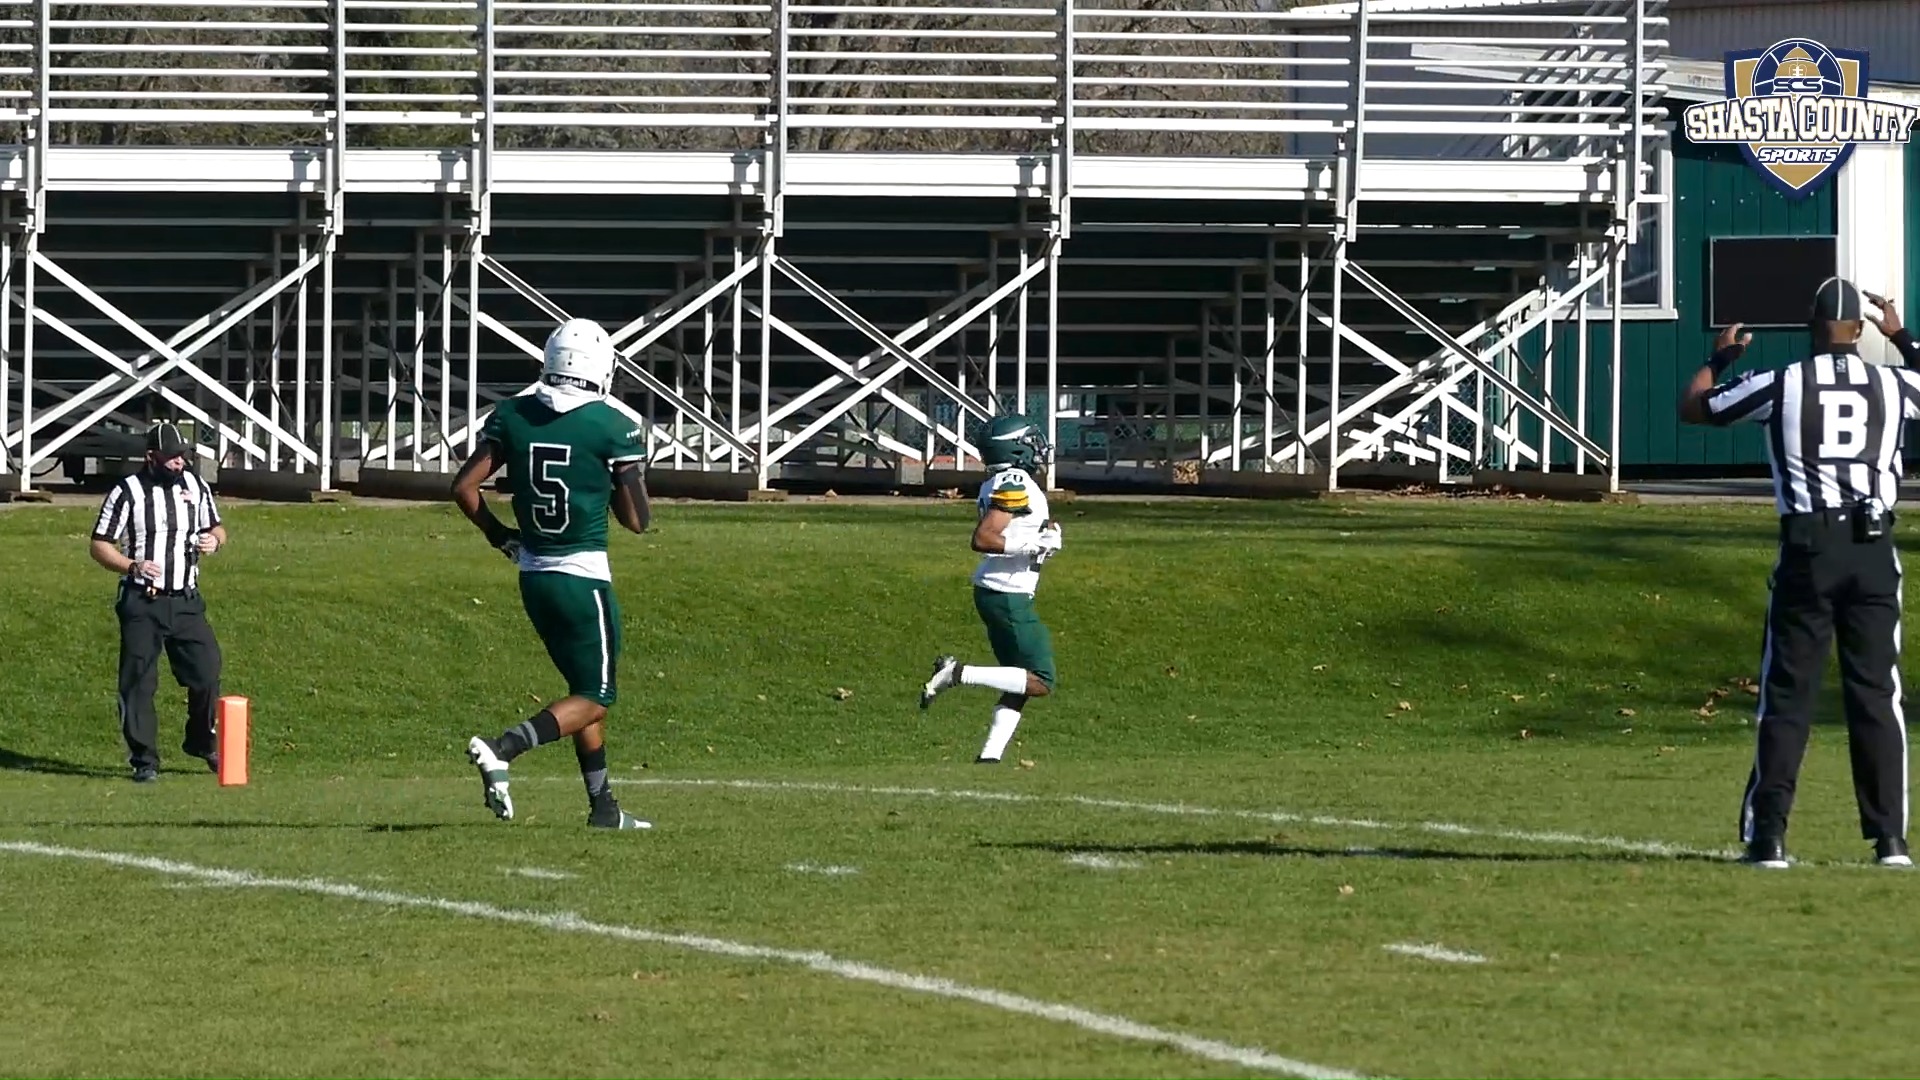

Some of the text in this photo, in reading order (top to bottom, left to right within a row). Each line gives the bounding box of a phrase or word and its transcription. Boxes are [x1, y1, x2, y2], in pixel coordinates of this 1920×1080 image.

[550, 375, 587, 388] Riddell
[1818, 390, 1869, 459] B
[529, 442, 571, 534] 5
